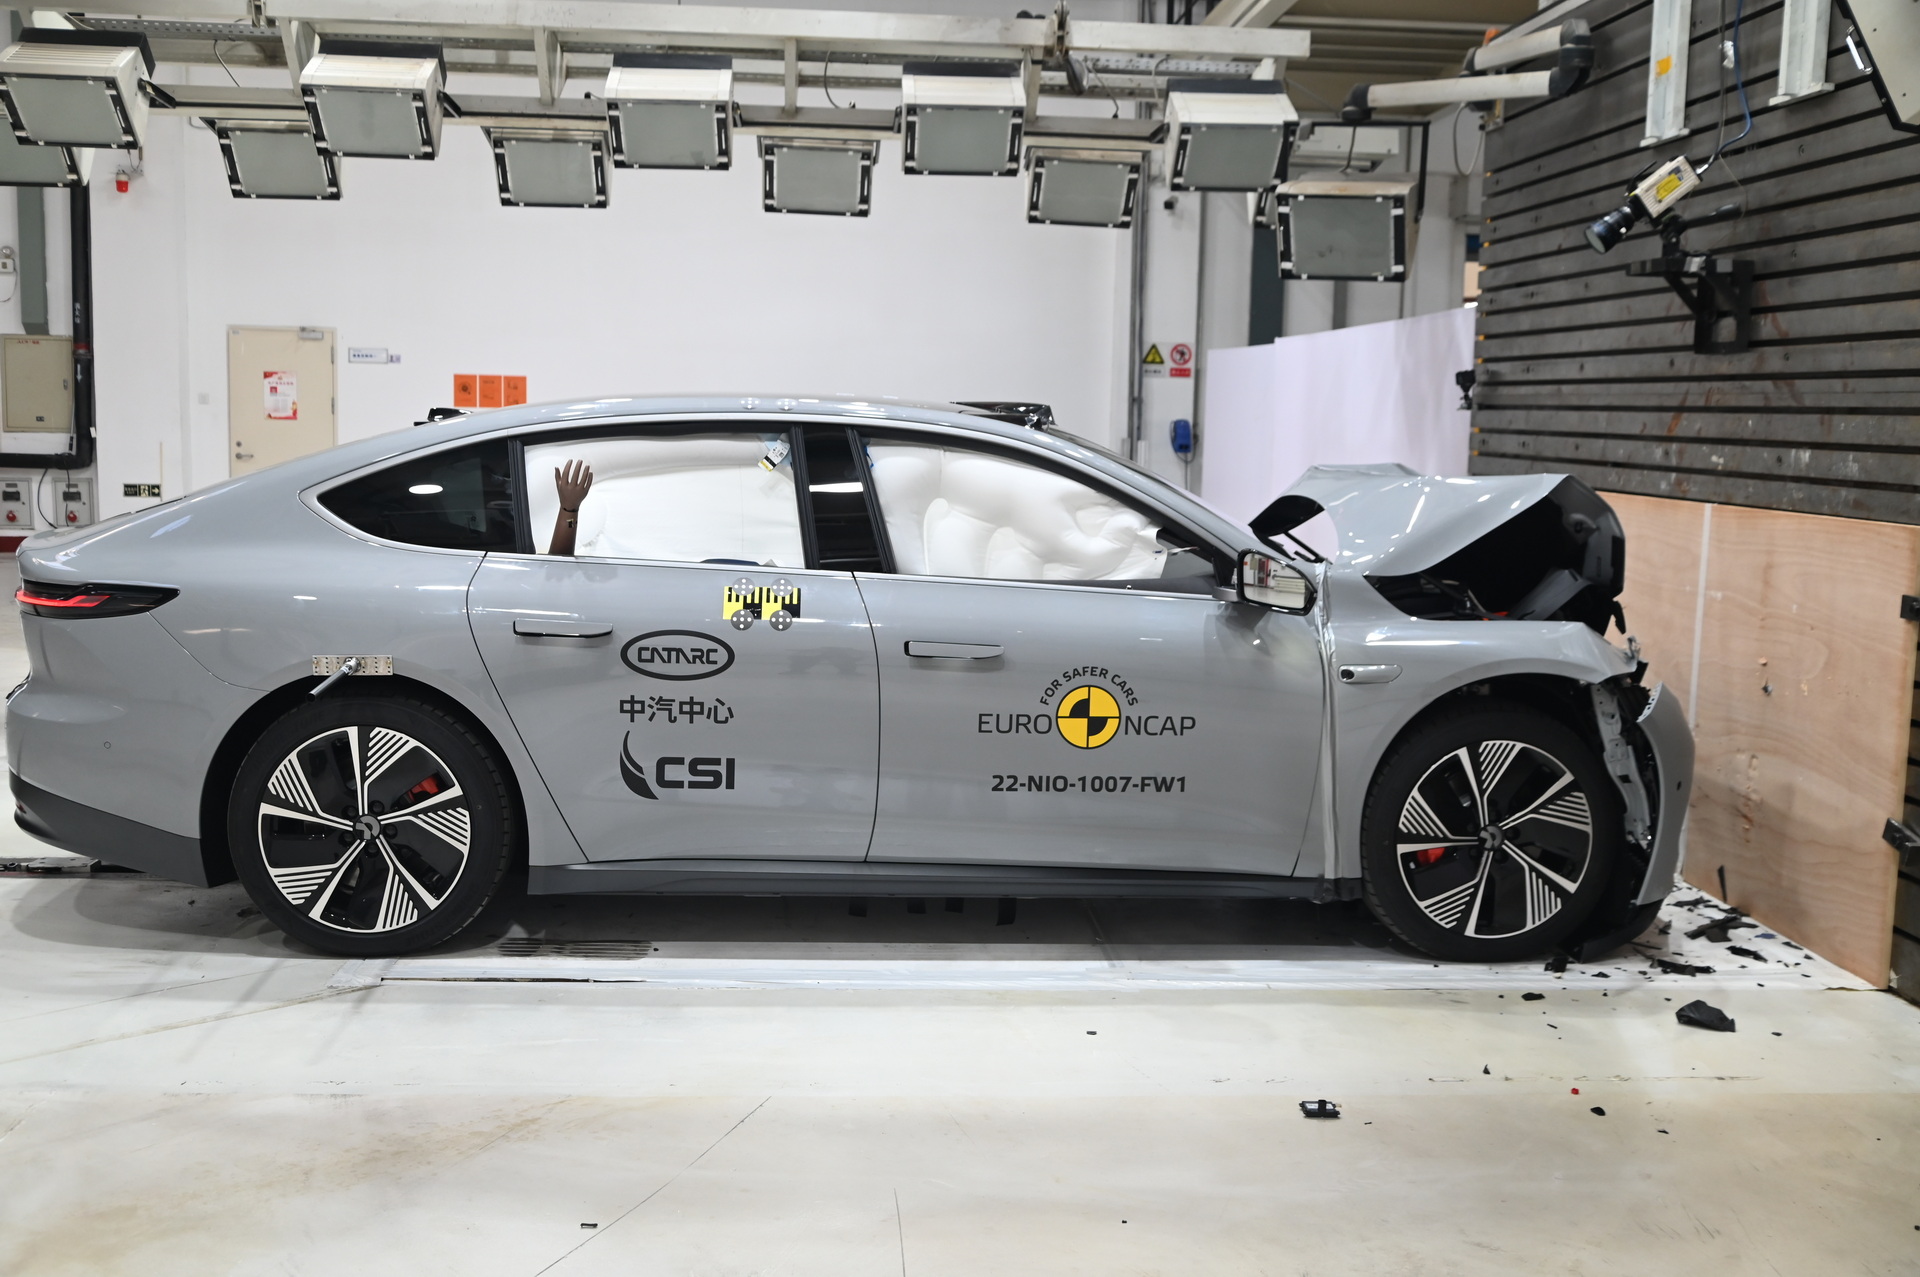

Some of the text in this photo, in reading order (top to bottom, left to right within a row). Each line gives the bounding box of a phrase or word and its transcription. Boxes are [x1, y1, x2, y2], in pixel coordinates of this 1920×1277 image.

[637, 646, 718, 665] CATARC
[1040, 666, 1139, 707] FOR SAFER CARS
[619, 694, 735, 724] 中汽中心
[978, 713, 1197, 736] EURO NCAP
[655, 756, 736, 790] CSI
[991, 774, 1186, 793] 22-NIO-1007-FW1
